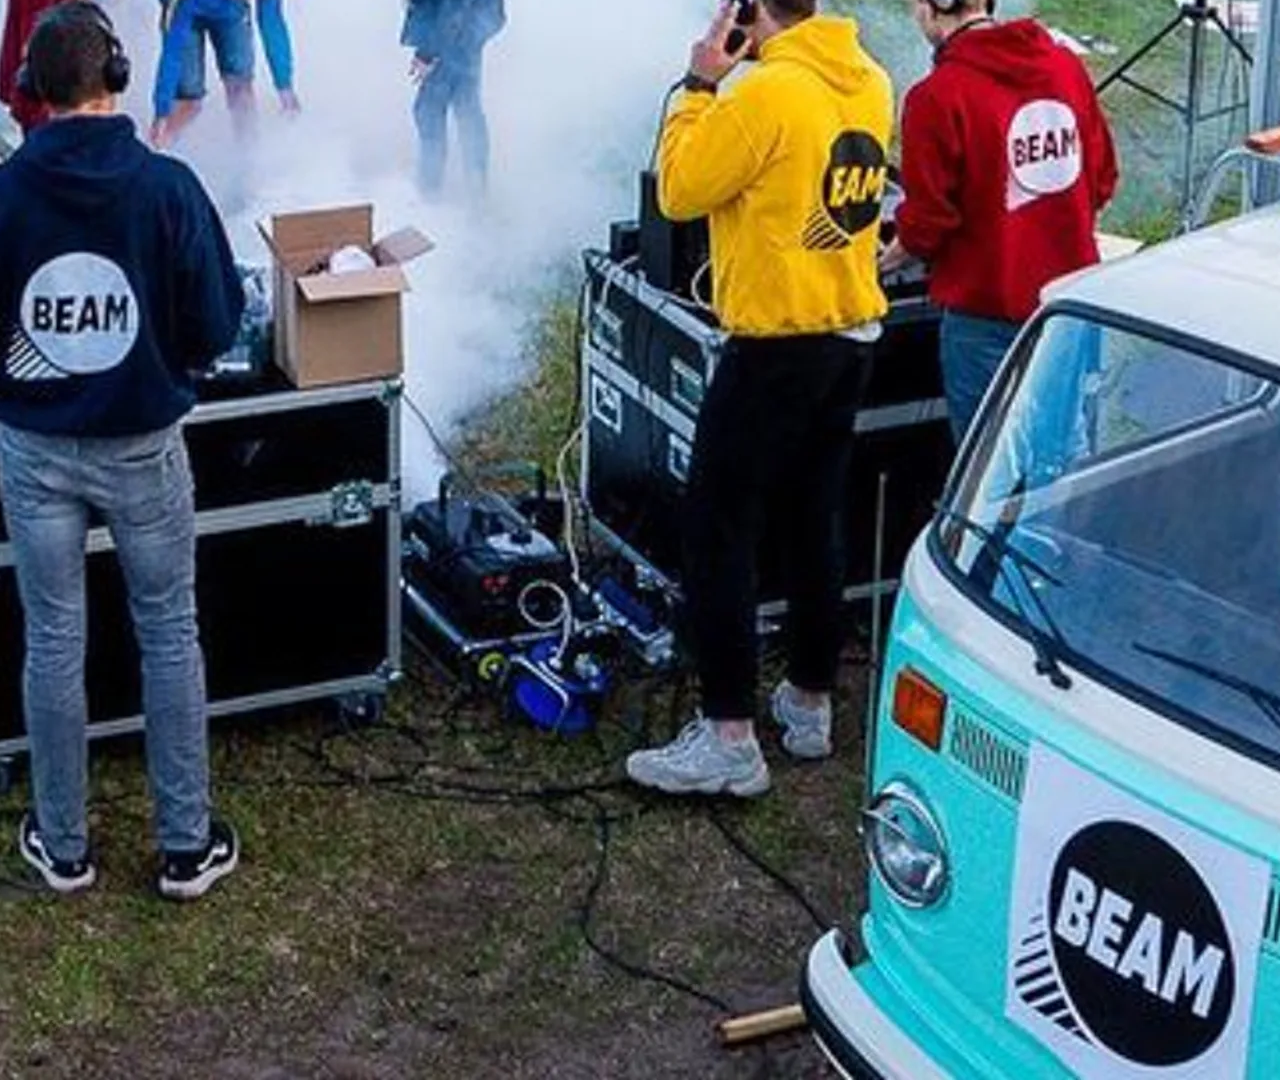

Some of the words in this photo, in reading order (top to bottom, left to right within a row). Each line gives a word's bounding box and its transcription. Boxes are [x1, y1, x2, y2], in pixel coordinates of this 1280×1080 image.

[1013, 127, 1076, 168] BEAM
[829, 165, 887, 208] EAM
[31, 292, 129, 335] BEAM
[1054, 867, 1226, 1019] BEAM
